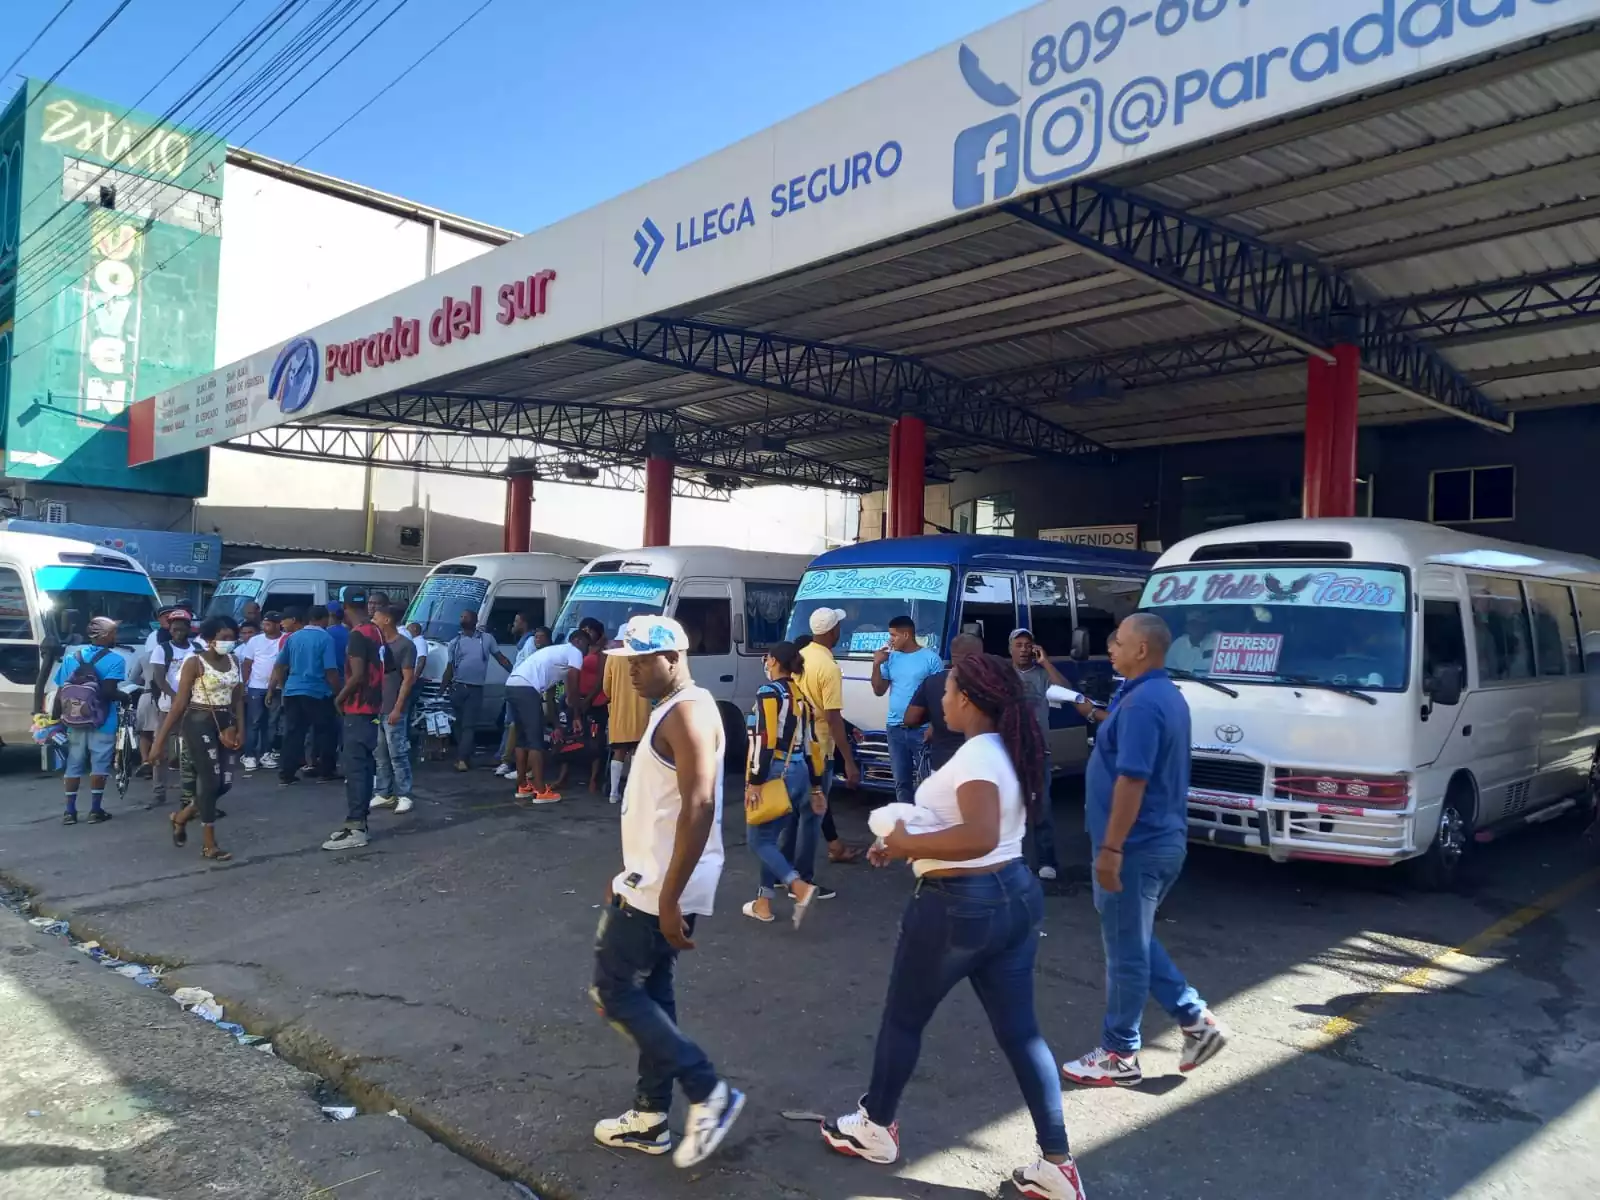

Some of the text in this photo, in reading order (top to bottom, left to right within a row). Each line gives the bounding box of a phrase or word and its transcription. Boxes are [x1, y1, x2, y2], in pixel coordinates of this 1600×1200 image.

[1028, 0, 1250, 86] 809-6
[676, 140, 903, 252] LLEGA SEGURO
[325, 268, 557, 381] Parada del sur
[169, 561, 198, 575] toca
[1152, 575, 1198, 602] Del
[1312, 572, 1397, 605] Tours
[1220, 635, 1277, 651] EXPRESO
[1215, 650, 1275, 673] SAN JUAN
